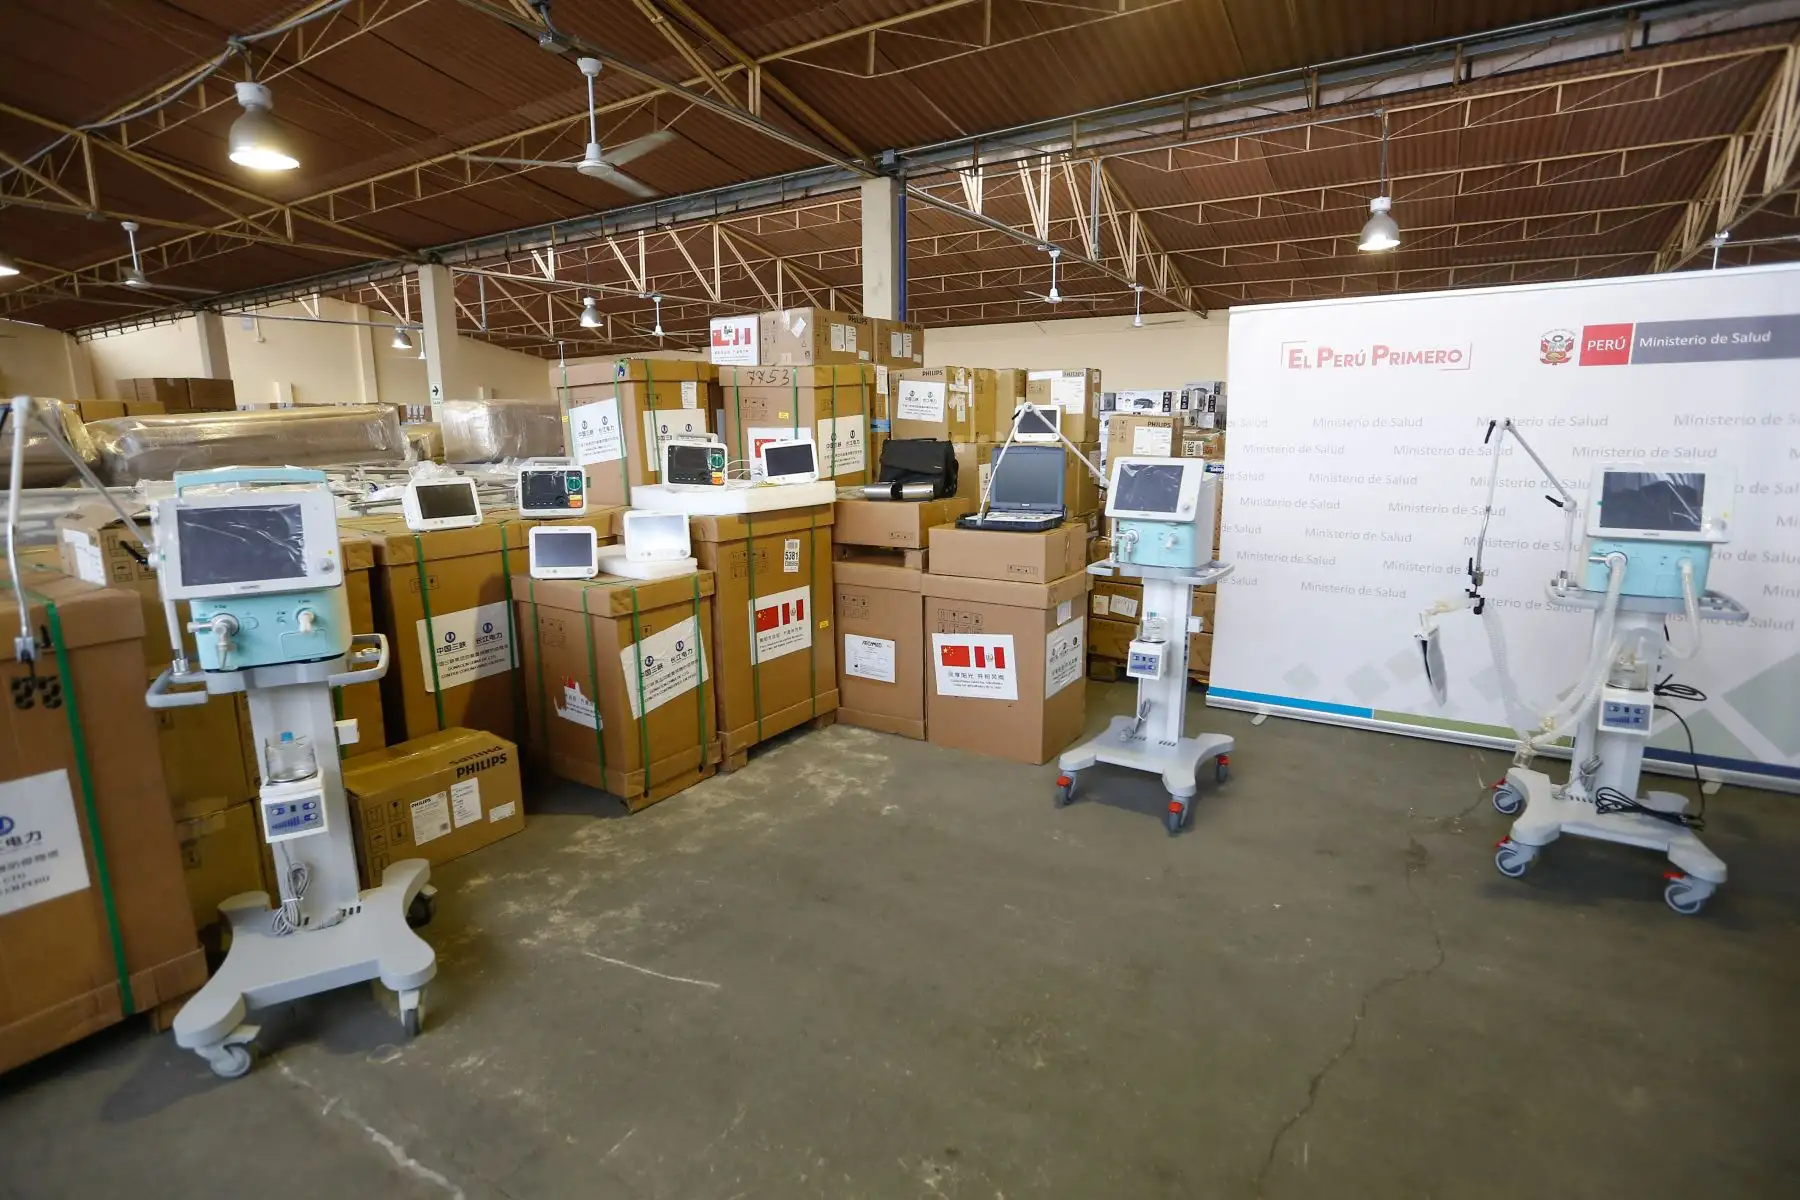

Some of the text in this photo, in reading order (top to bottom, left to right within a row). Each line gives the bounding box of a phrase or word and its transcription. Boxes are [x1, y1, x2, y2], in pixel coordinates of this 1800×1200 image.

[1587, 336, 1626, 351] PERÚ
[1640, 331, 1772, 348] Ministerio de Salud
[1288, 344, 1463, 370] EL PERÚ PRIMERO
[1673, 413, 1756, 428] Ministerio
[1393, 446, 1455, 456] Ministerio
[1240, 496, 1340, 510] Ministerio de Salud
[1388, 502, 1448, 514] Ministerio
[1452, 504, 1468, 515] de
[1305, 527, 1412, 543] Ministerio de Salud
[1237, 550, 1336, 566] Ministerio de Salud
[1383, 560, 1442, 574] Ministerio
[1301, 581, 1406, 599] Ministerio de Salud
[456, 752, 508, 778] PHILIPS
[411, 798, 432, 808] PHILIPS
[0, 830, 42, 848] 电力
